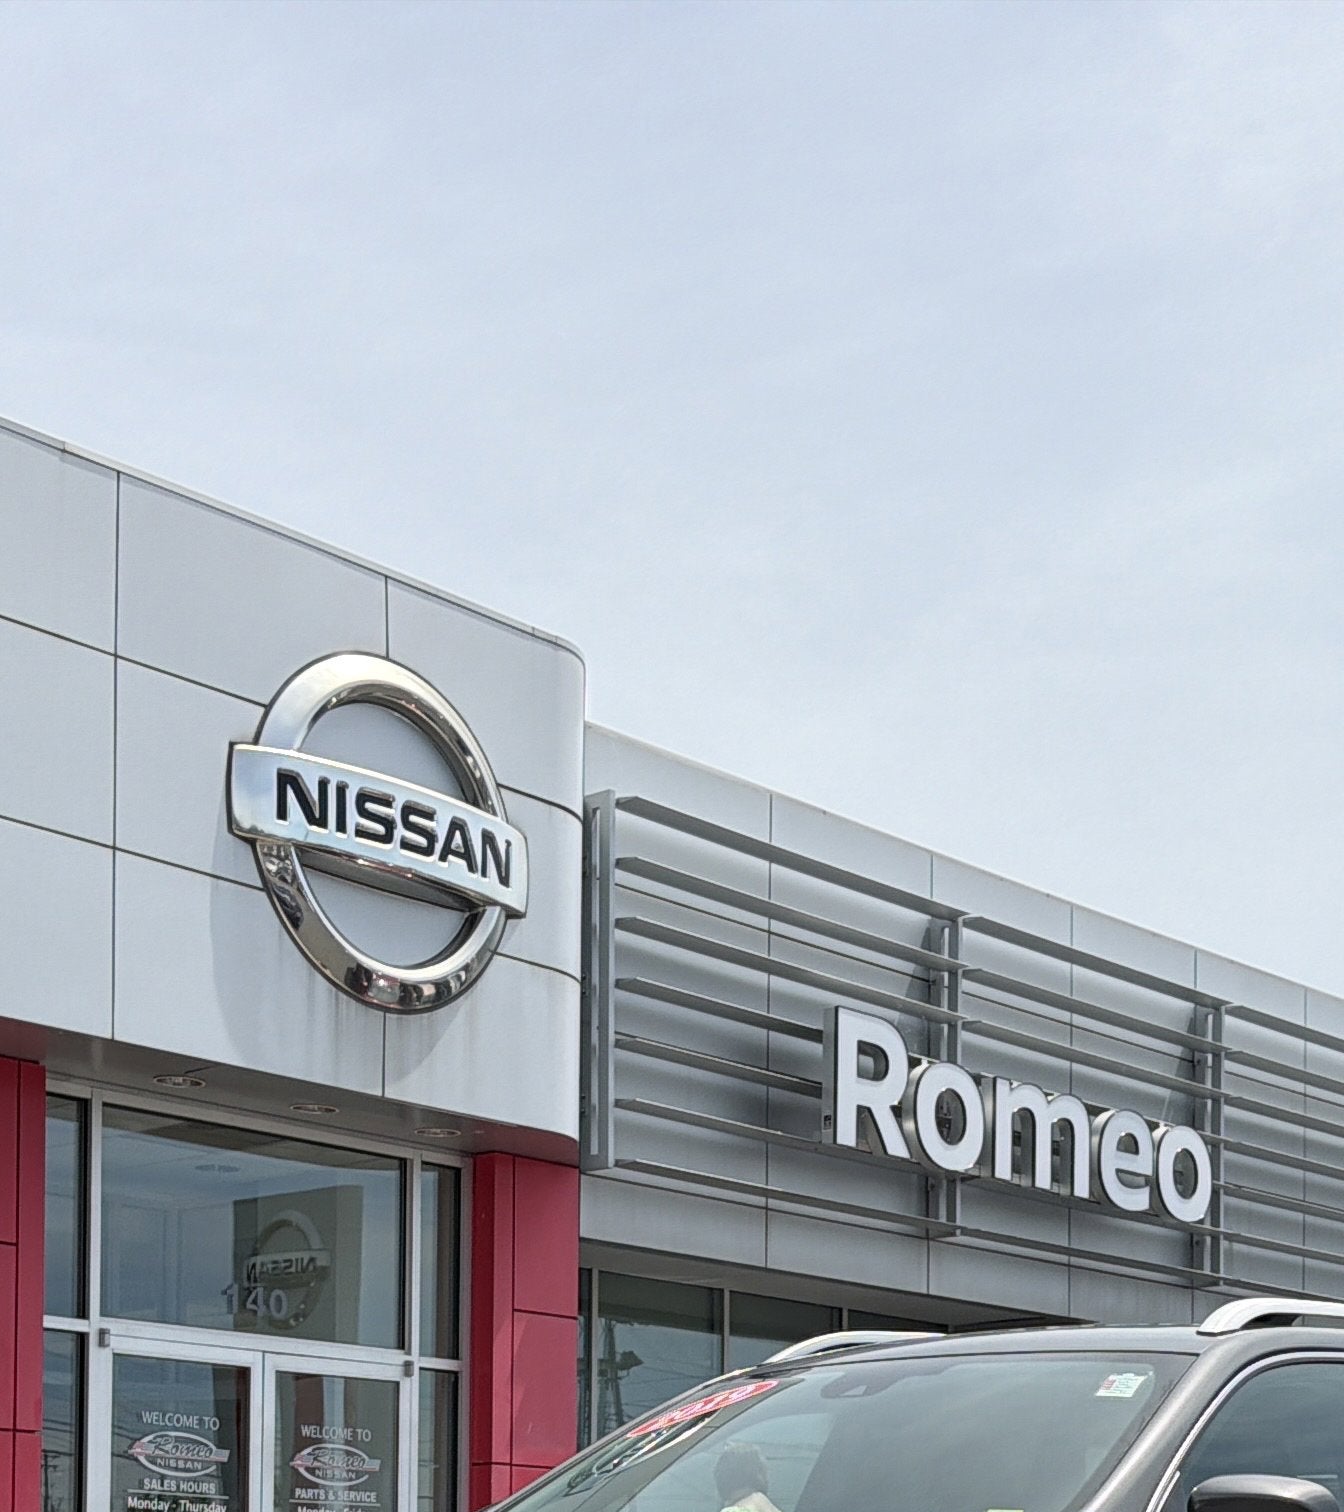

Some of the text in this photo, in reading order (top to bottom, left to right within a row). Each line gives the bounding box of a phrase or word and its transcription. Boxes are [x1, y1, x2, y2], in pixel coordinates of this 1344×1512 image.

[275, 767, 513, 890] NISSAN
[828, 1005, 1213, 1223] Romeo
[222, 1281, 288, 1320] 140
[141, 1410, 220, 1431] WELCOME TO
[300, 1424, 372, 1442] WELCOME TO
[146, 1433, 214, 1458] Romeo
[156, 1458, 202, 1470] NISSAN
[315, 1468, 356, 1479] NISSAN
[143, 1478, 216, 1494] SALES HOURS
[295, 1488, 326, 1500] PARTS
[337, 1490, 377, 1502] SERVICE
[127, 1496, 170, 1512] Monday
